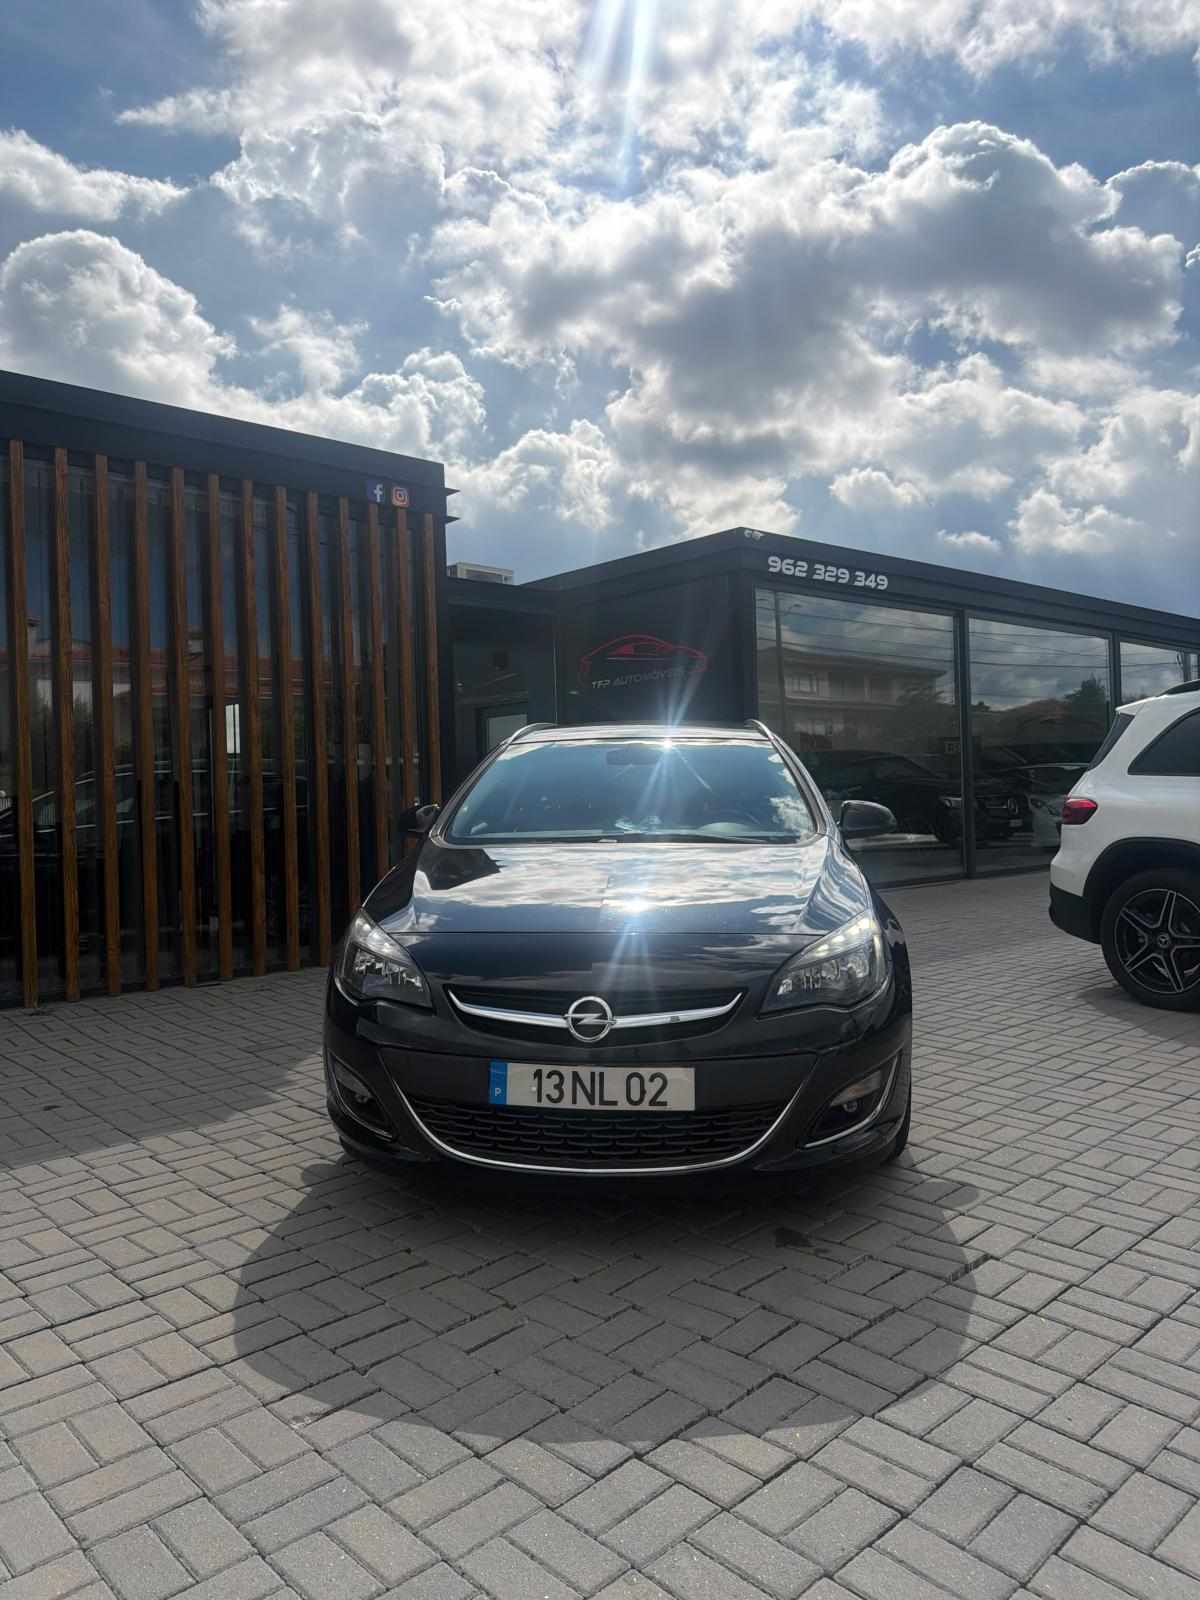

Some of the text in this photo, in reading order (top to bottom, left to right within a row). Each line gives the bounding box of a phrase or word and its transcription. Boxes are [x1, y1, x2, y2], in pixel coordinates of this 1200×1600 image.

[767, 555, 889, 591] 962 329 349
[494, 1088, 502, 1097] P
